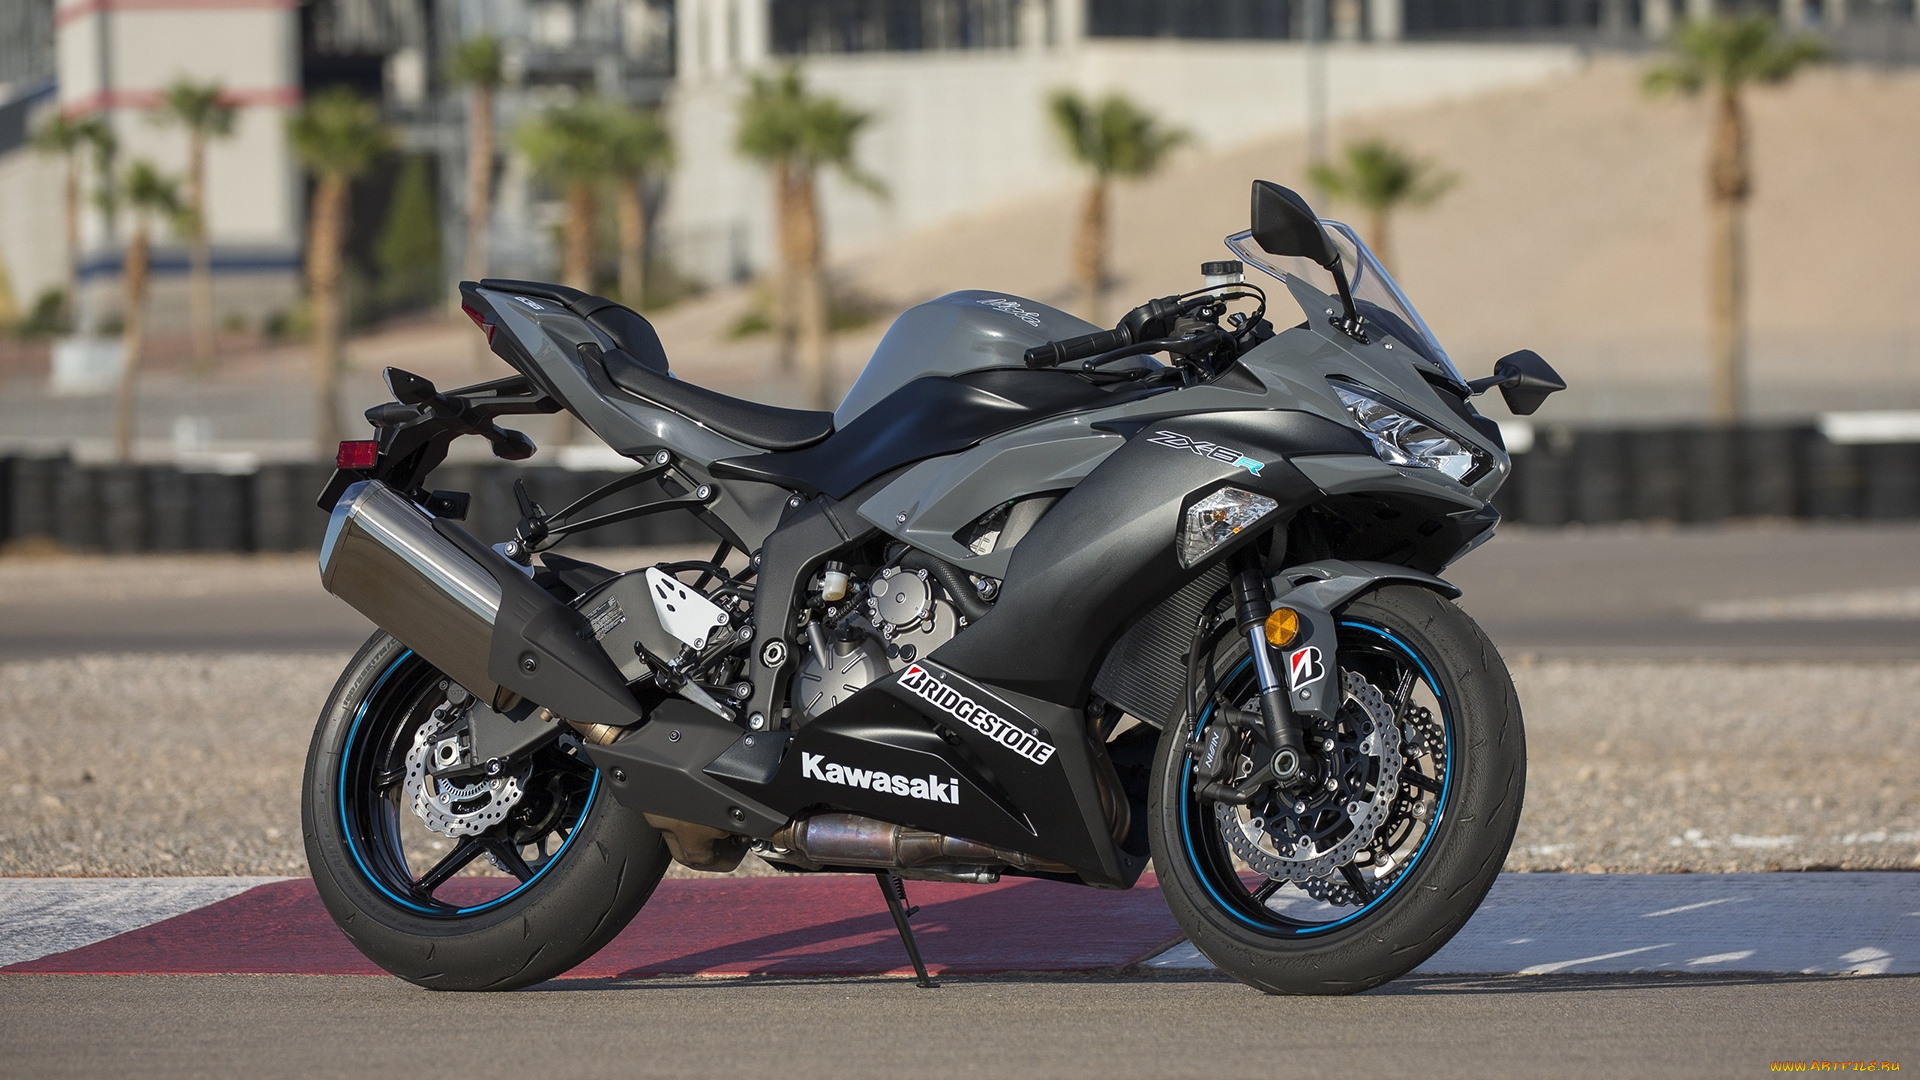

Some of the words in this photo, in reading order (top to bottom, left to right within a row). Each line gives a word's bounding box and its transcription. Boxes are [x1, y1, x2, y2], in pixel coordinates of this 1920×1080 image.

[1146, 430, 1265, 477] ZX-6R
[899, 665, 1055, 764] BRIDGESTONE
[801, 751, 959, 805] Kawasaki
